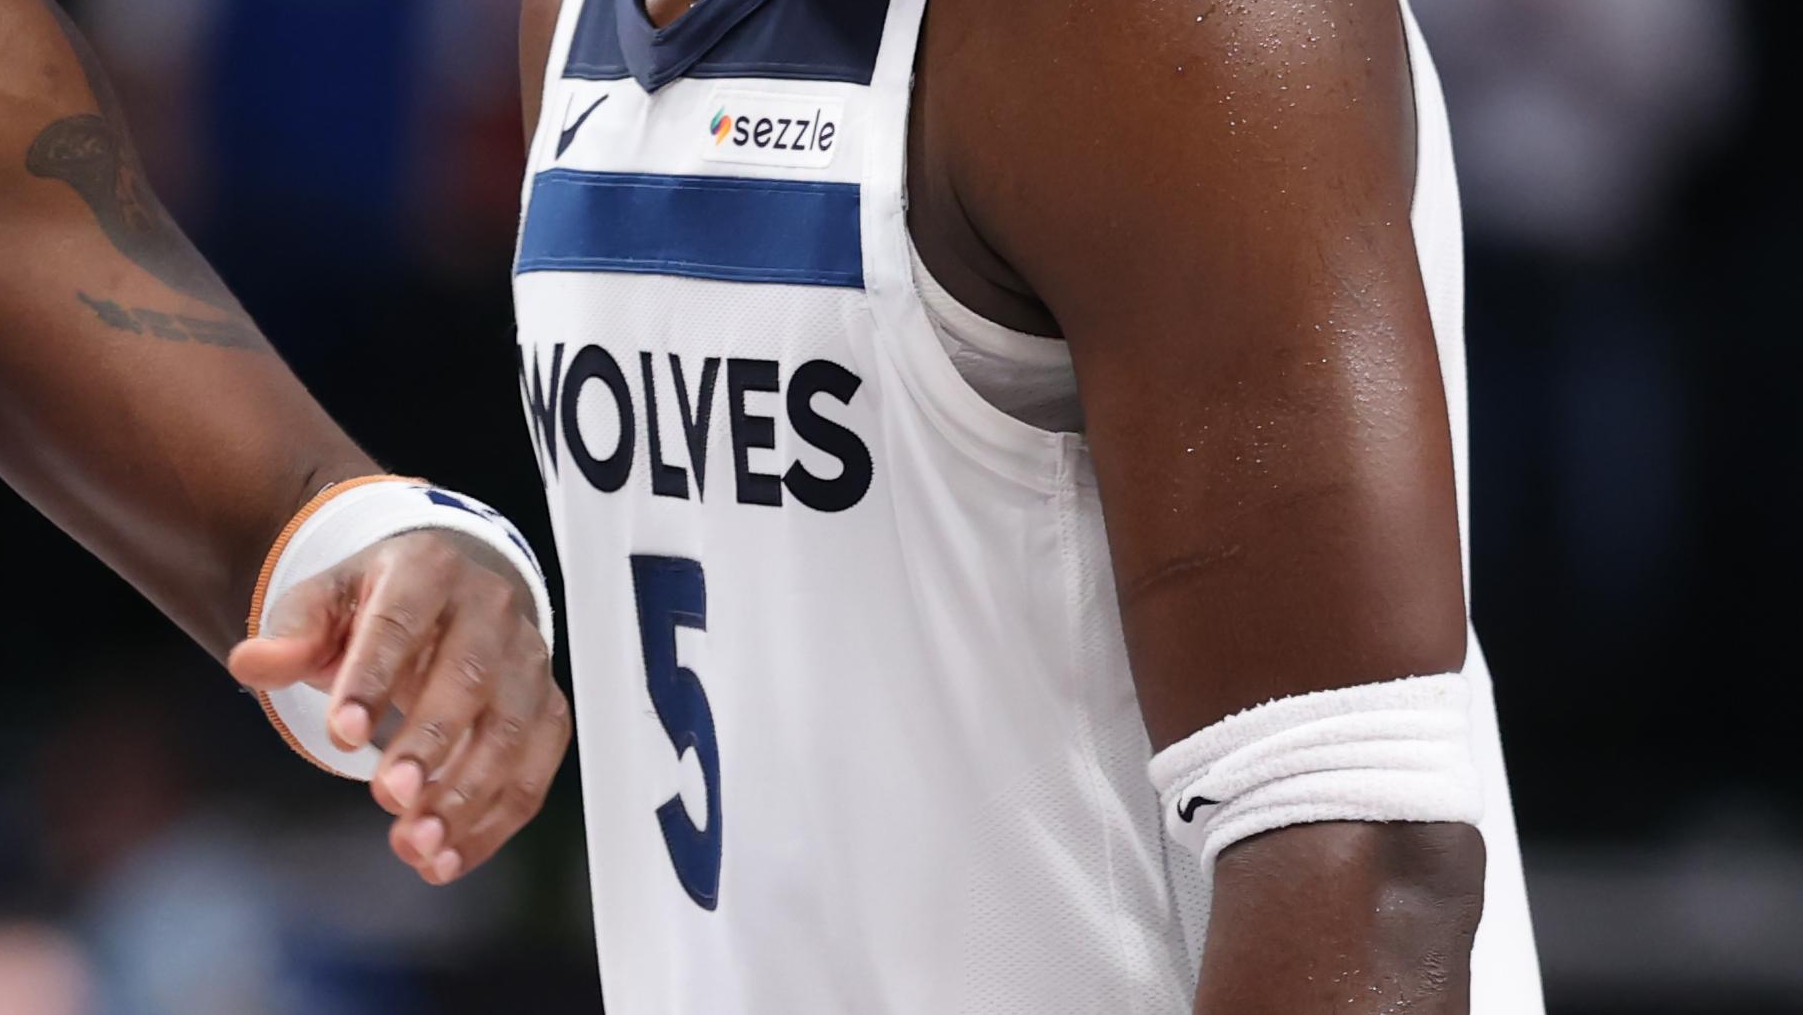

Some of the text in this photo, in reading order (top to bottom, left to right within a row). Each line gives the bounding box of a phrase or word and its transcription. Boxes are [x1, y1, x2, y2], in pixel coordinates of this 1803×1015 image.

[733, 108, 835, 152] sezzle
[517, 343, 874, 512] WOLVES
[629, 554, 723, 912] 5
